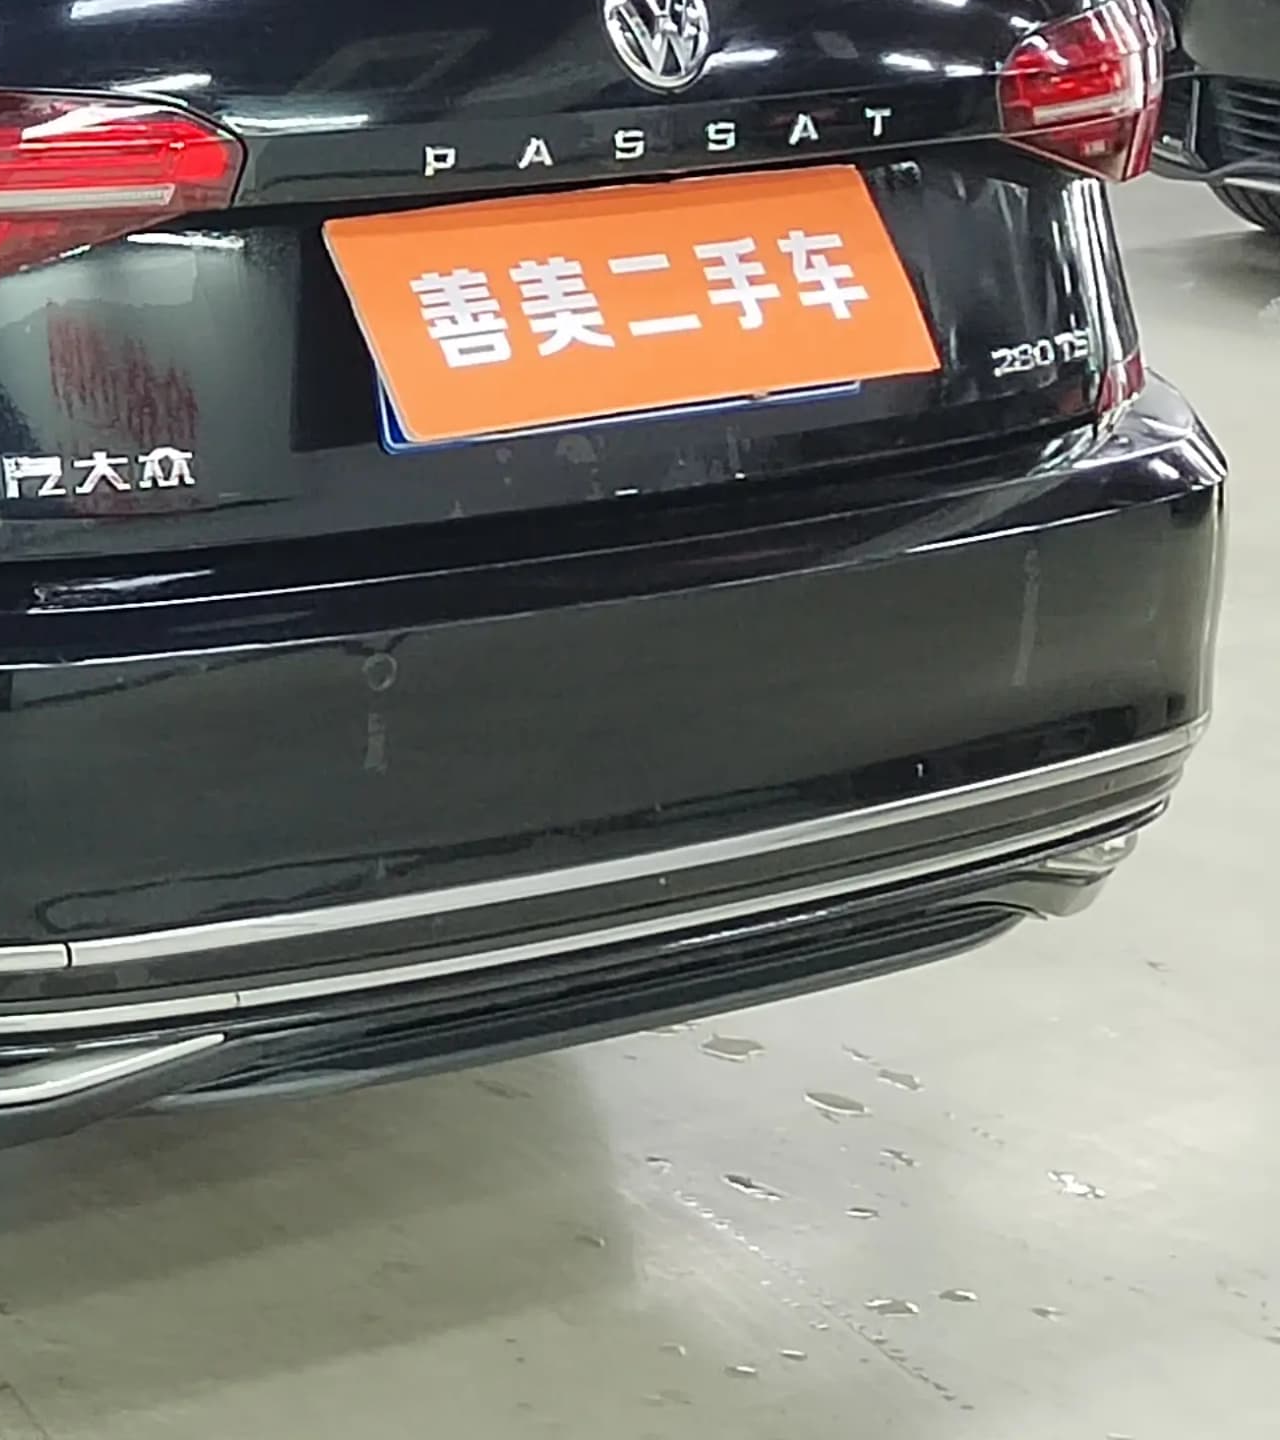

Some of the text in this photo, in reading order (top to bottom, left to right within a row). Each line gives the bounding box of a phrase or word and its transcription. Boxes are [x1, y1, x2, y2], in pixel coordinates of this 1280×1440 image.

[422, 106, 892, 176] PASSAT
[408, 228, 870, 369] 善美二手车
[990, 338, 1055, 378] 280
